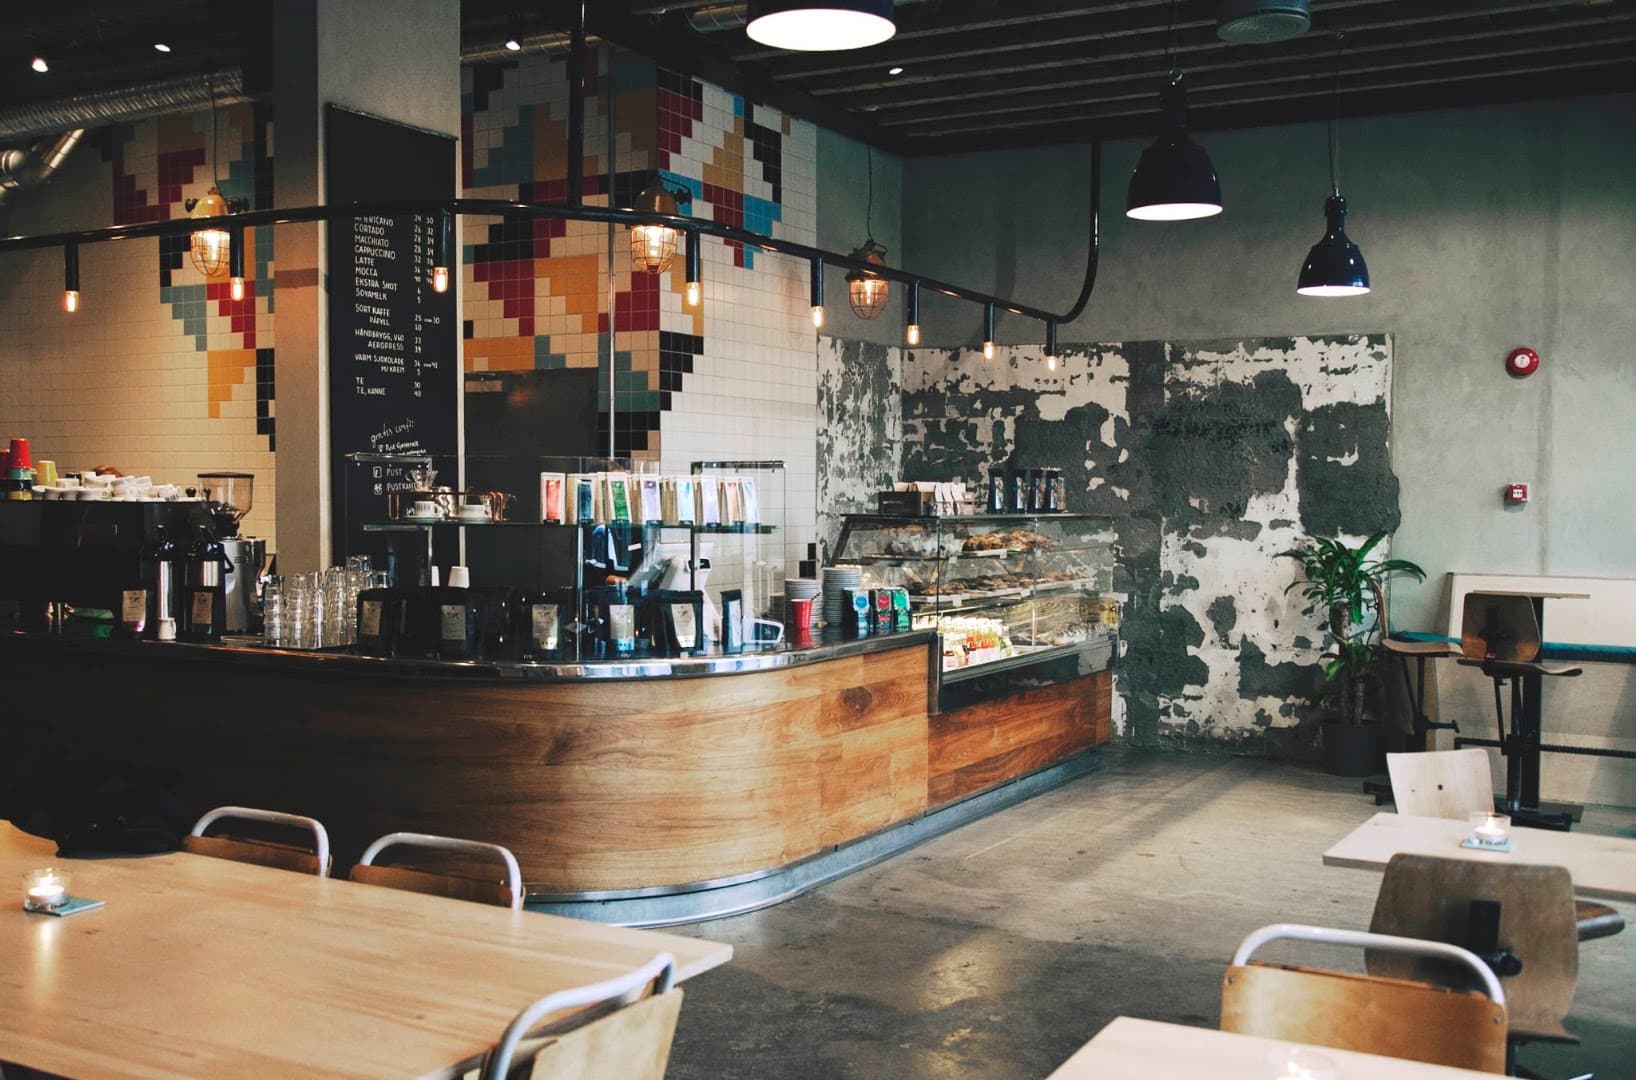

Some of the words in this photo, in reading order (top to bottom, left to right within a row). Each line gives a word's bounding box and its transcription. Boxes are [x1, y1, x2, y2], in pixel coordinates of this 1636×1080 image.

[354, 216, 394, 227] ERICANO
[354, 223, 385, 236] CORTADO
[354, 235, 390, 247] MACCHIATO
[354, 245, 396, 260] CAPPUCCINO
[355, 256, 375, 266] LATTE
[355, 267, 378, 276] MOCCA
[355, 277, 379, 288] EKSTRA
[382, 281, 397, 291] SHOT
[355, 288, 387, 300] SOYAMELK
[355, 304, 371, 313] SORT
[372, 306, 390, 317] KAFFE
[368, 340, 404, 351] AEROPRESS
[373, 355, 404, 366] SJOKOLADE
[389, 366, 405, 374] KREM
[356, 376, 364, 385] TE
[367, 387, 386, 396] KANNE
[386, 468, 403, 477] PUST
